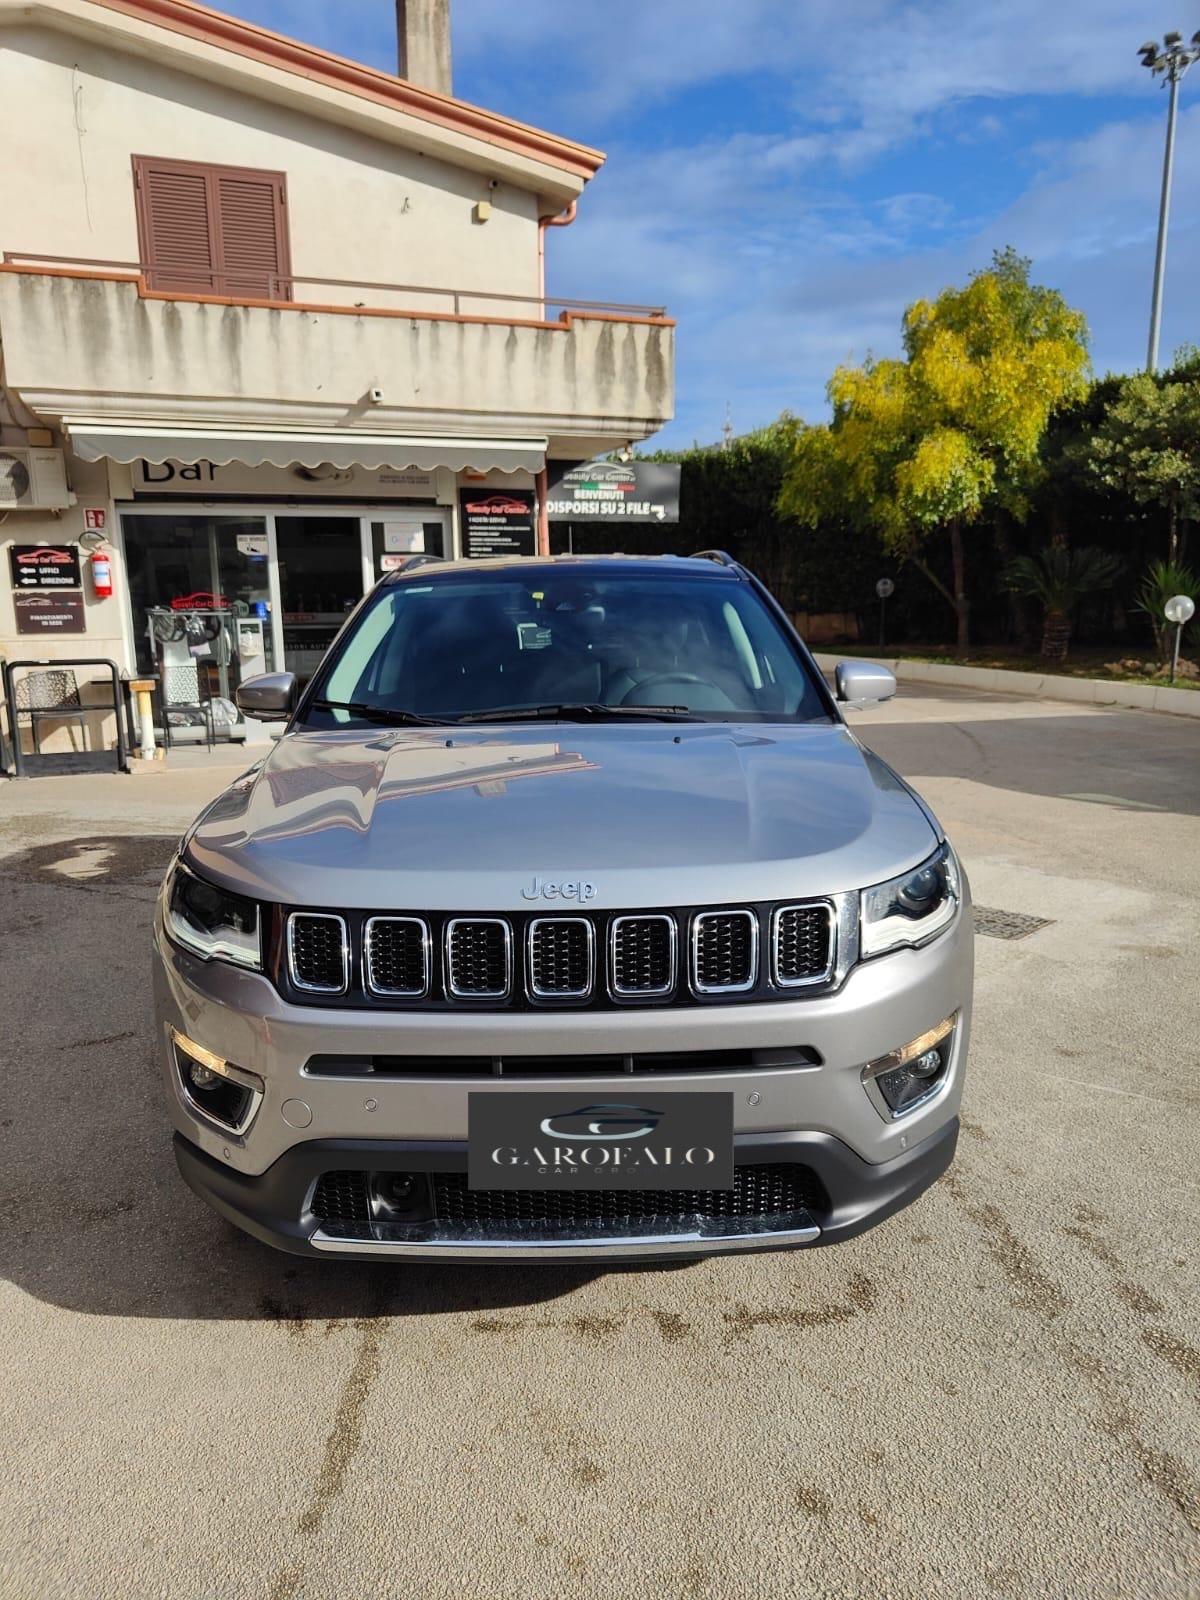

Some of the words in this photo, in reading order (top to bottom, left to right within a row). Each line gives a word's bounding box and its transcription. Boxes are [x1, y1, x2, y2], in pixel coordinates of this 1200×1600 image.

[574, 490, 625, 501] BENVENUTI
[546, 501, 599, 514] DISPORSI
[600, 502, 615, 515] SU
[616, 502, 626, 515] 2
[627, 502, 651, 515] FILE
[520, 876, 598, 904] Jeep
